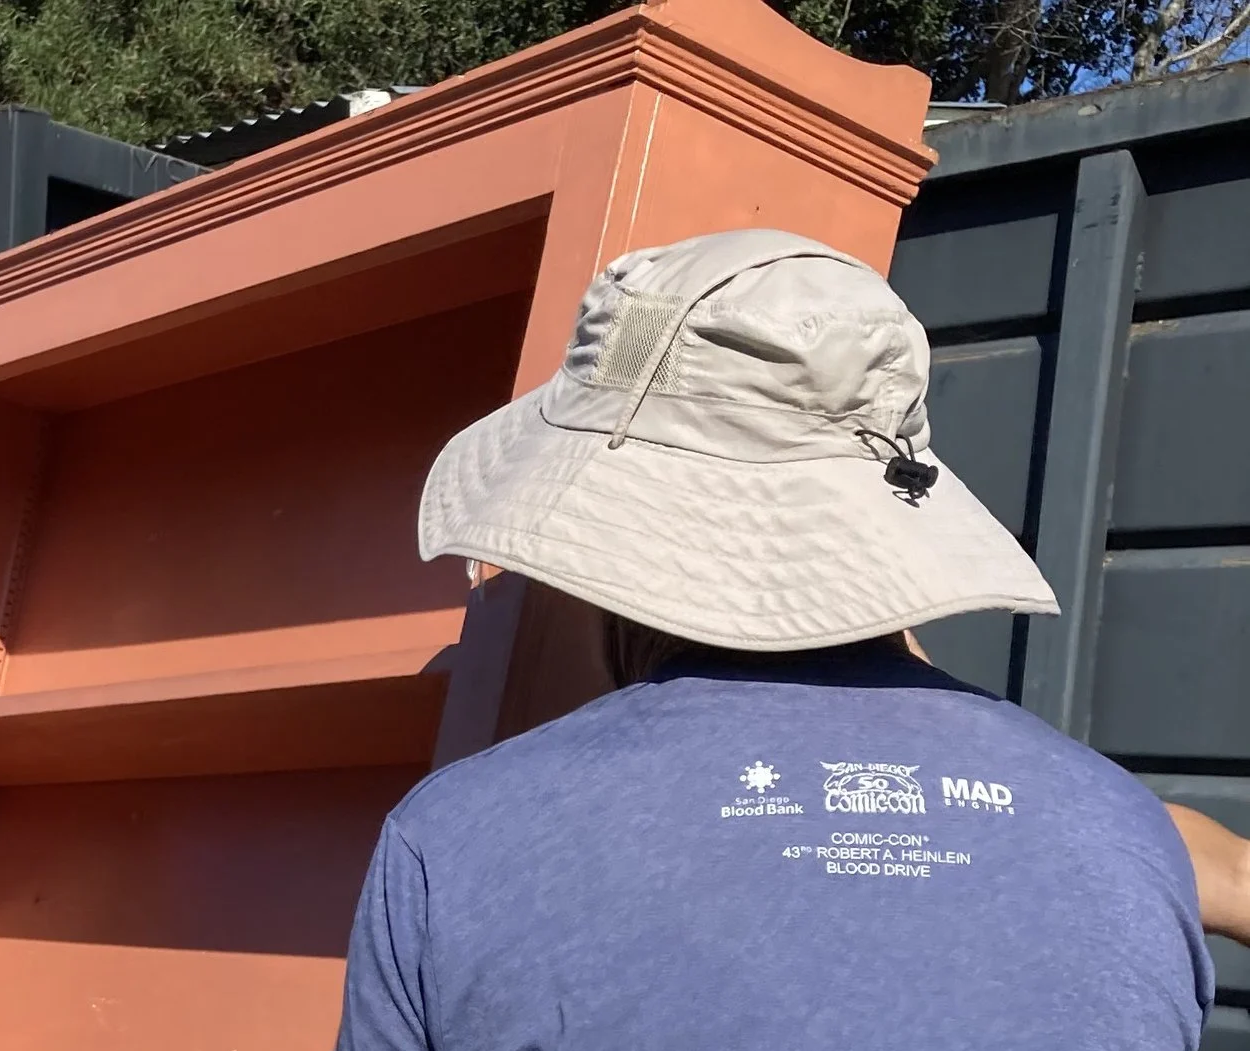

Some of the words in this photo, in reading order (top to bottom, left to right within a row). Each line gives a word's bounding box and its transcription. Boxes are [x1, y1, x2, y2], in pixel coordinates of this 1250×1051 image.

[833, 762, 863, 775] SAN
[868, 763, 910, 777] DIEGO
[858, 777, 889, 790] 50
[941, 776, 1013, 806] MAD
[735, 797, 755, 805] San
[757, 796, 790, 806] Diego
[944, 798, 1015, 815] ENGINE
[721, 804, 764, 818] Blood
[766, 803, 804, 815] Bank
[816, 847, 881, 861] ROBERT
[882, 849, 897, 861] A.
[901, 849, 971, 865] HEINLEIN
[826, 861, 881, 876] BLOOD
[884, 863, 931, 878] DRIVE
